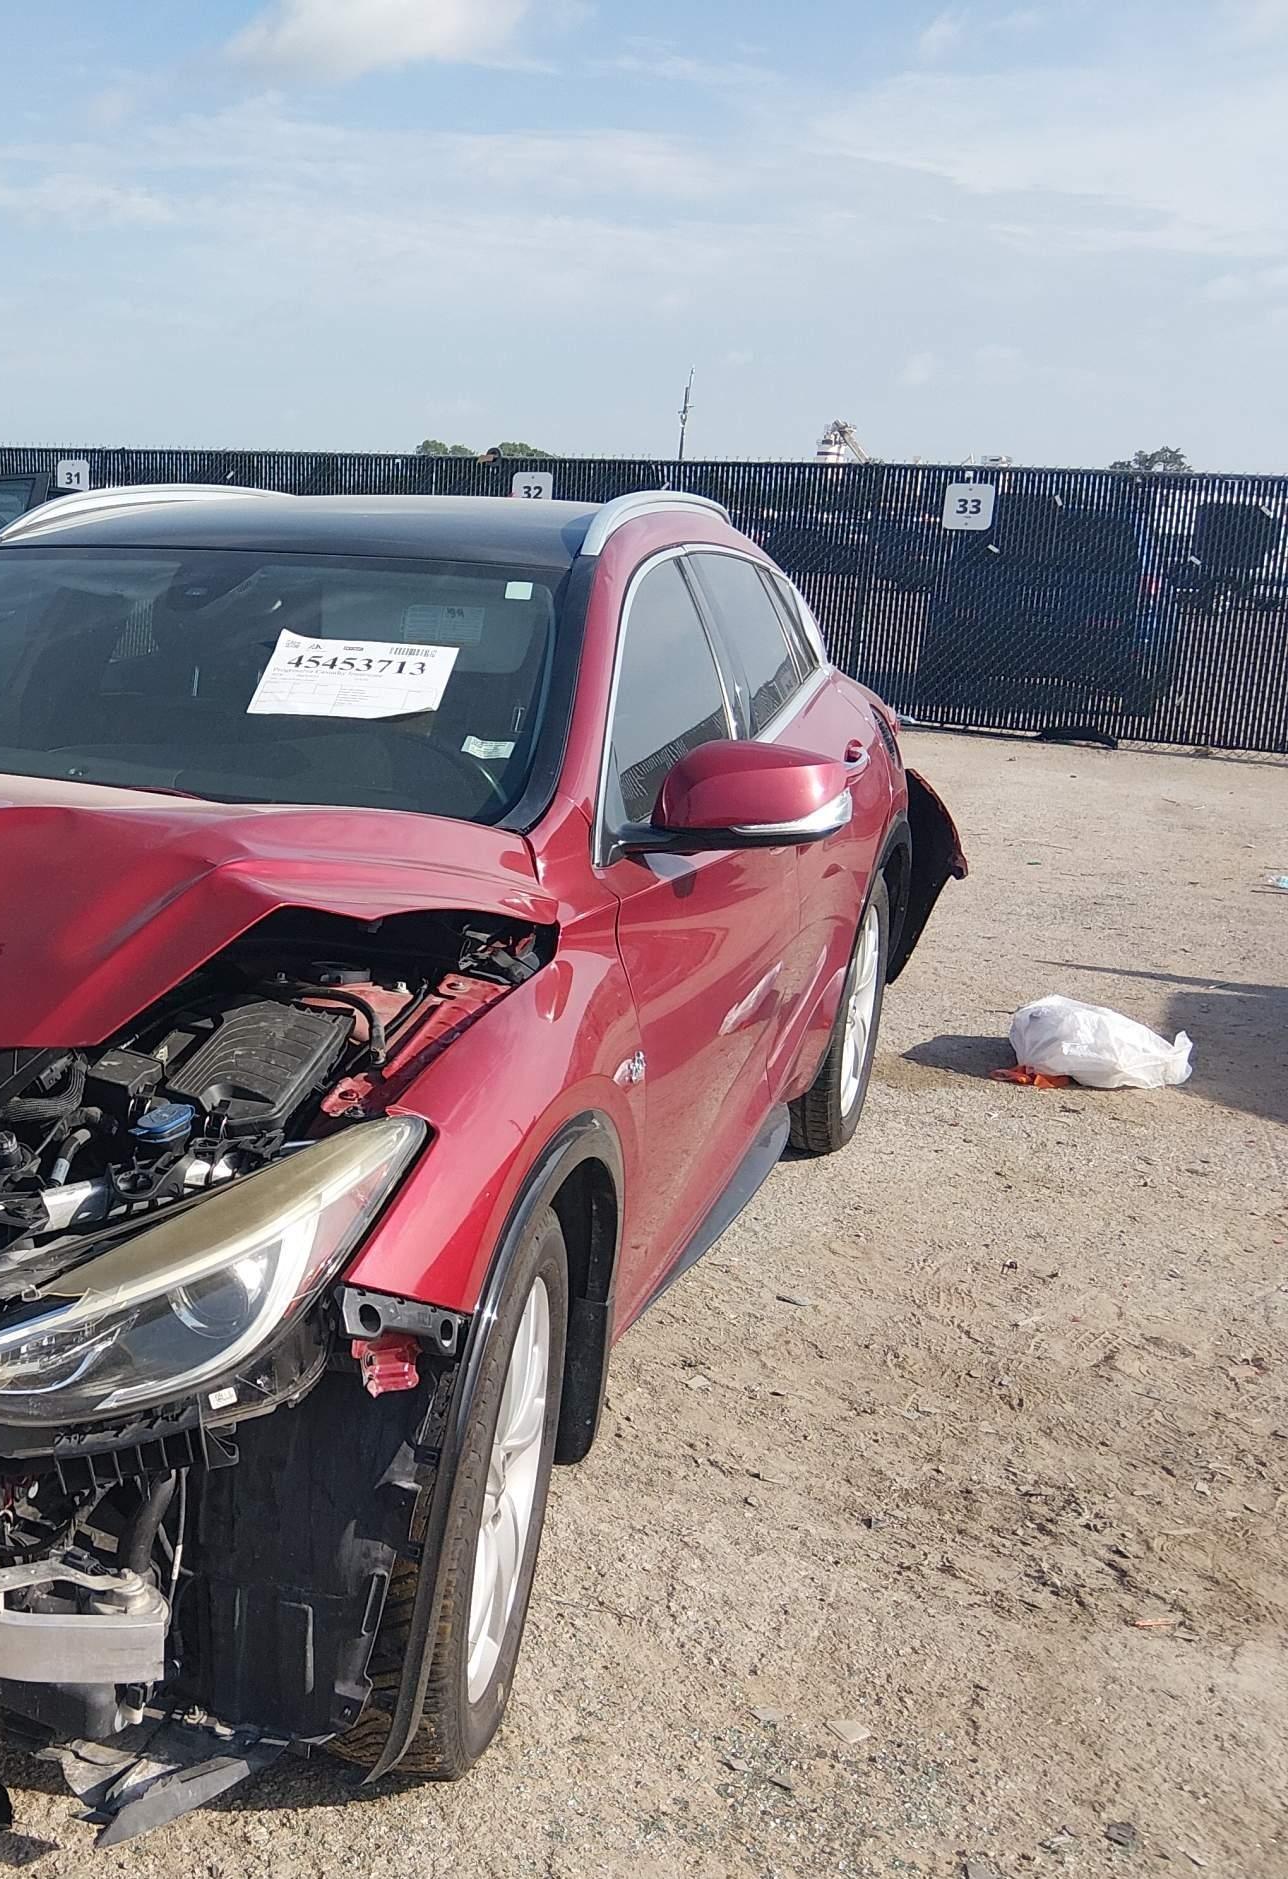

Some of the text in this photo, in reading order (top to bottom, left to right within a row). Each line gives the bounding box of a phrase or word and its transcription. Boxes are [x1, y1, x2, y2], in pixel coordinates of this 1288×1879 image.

[65, 472, 81, 485] 31
[522, 486, 543, 499] 32
[956, 499, 982, 514] 33
[287, 654, 427, 676] 45453713
